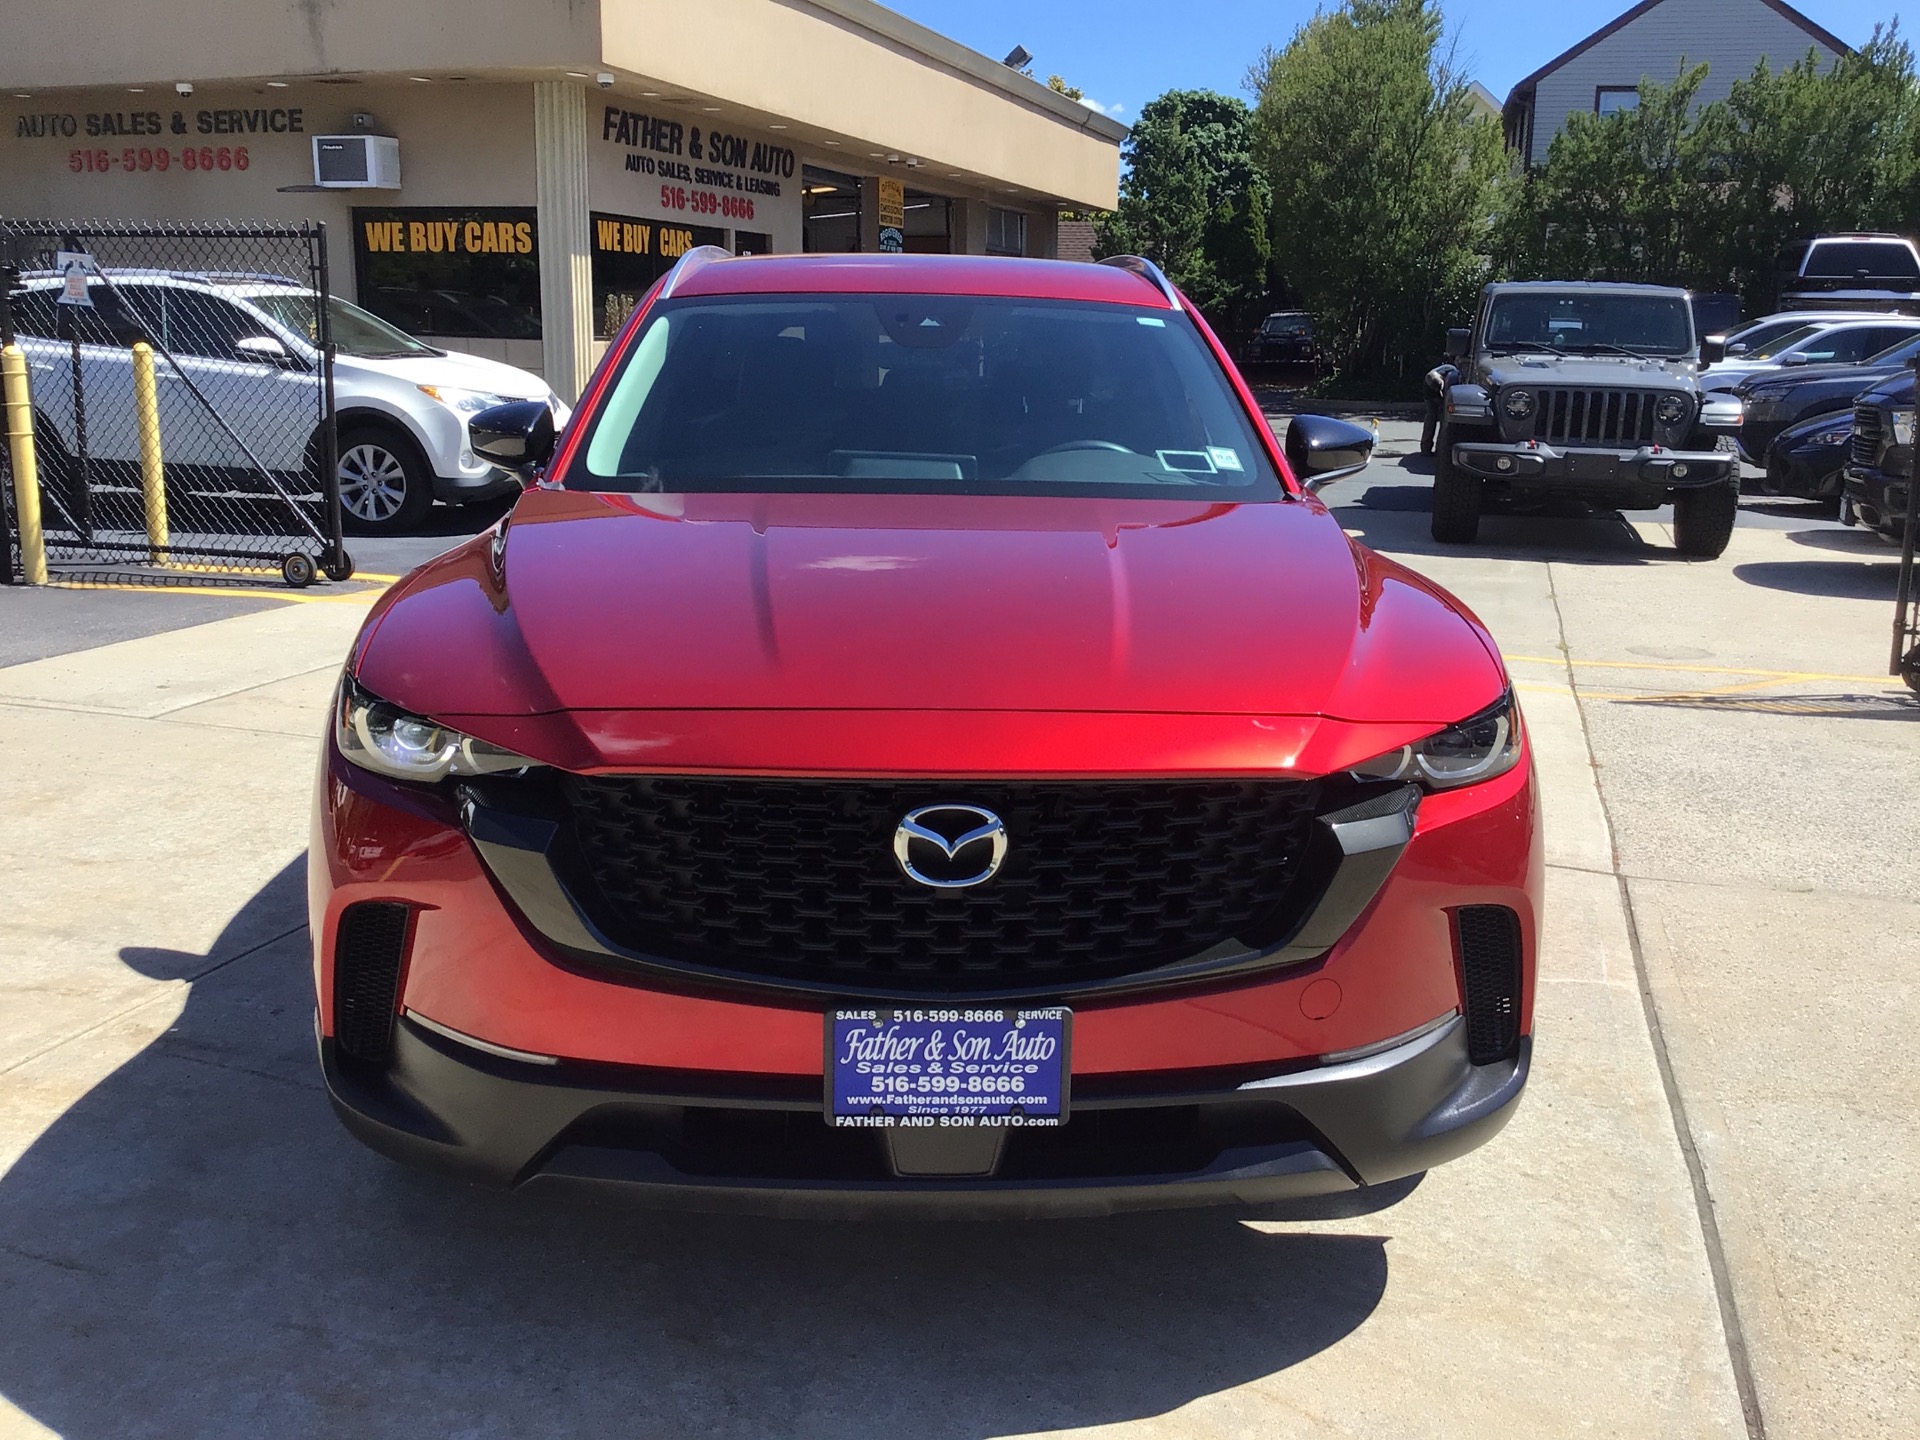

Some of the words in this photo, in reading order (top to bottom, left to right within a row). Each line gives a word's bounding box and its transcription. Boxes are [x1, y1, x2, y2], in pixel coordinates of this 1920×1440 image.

[17, 114, 77, 138] AUTO
[85, 112, 162, 136] SALES
[170, 111, 187, 135] &
[197, 109, 304, 134] SERVICE
[603, 106, 683, 156] FATHER
[689, 126, 703, 160] &
[708, 131, 748, 169] SON
[750, 142, 795, 179] AUTO
[68, 147, 249, 172] 516-599-8666
[625, 154, 655, 175] AUTO
[658, 160, 692, 184] SALES,
[695, 167, 733, 189] SERVICE
[736, 174, 743, 191] &
[745, 177, 781, 197] LEASING
[661, 185, 755, 221] 516-599-8666
[365, 222, 403, 252] WE
[409, 221, 459, 253] BUY
[465, 221, 533, 254] CARS
[597, 220, 622, 251] WE
[623, 223, 650, 254] BUY
[659, 227, 693, 257] CARS
[836, 1010, 876, 1020] SALES
[893, 1010, 1004, 1022] 516-599-8666
[1017, 1010, 1062, 1020] SERVICE
[840, 1025, 924, 1064] Father
[924, 1029, 946, 1061] &
[947, 1029, 992, 1061] Son
[994, 1029, 1056, 1061] Auto
[855, 1062, 921, 1074] Sales
[927, 1062, 944, 1074] &
[949, 1062, 1039, 1074] Service
[871, 1076, 1025, 1093] 516-599-8666
[847, 1094, 1047, 1105] www.Fatherandsonauto.com
[907, 1105, 949, 1114] Since
[953, 1106, 987, 1114] 1977
[836, 1116, 895, 1127] FATHER
[900, 1116, 935, 1127] AND
[940, 1116, 974, 1127] SON
[980, 1116, 1058, 1127] AUTO.com
